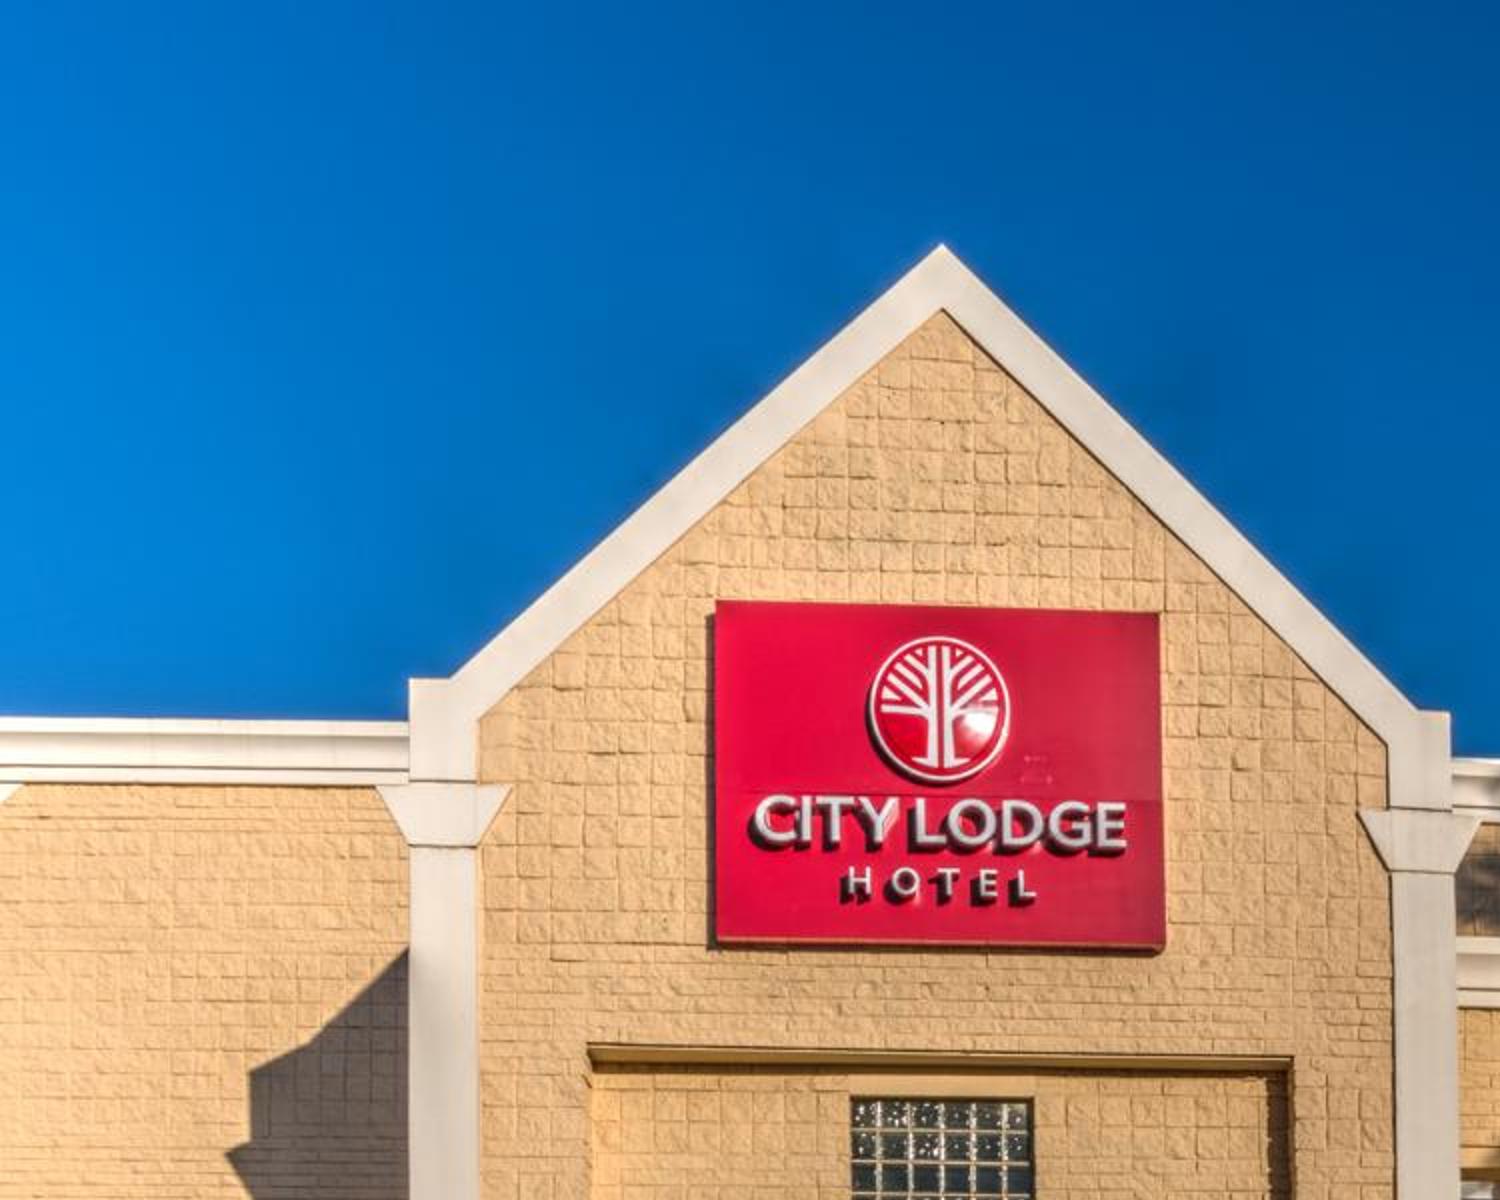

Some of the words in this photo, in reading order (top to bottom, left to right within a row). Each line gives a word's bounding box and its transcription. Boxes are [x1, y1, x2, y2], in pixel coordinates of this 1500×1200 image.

[753, 794, 900, 845] CITY
[915, 797, 1127, 849] LODGE
[847, 866, 1037, 898] HOTEL
